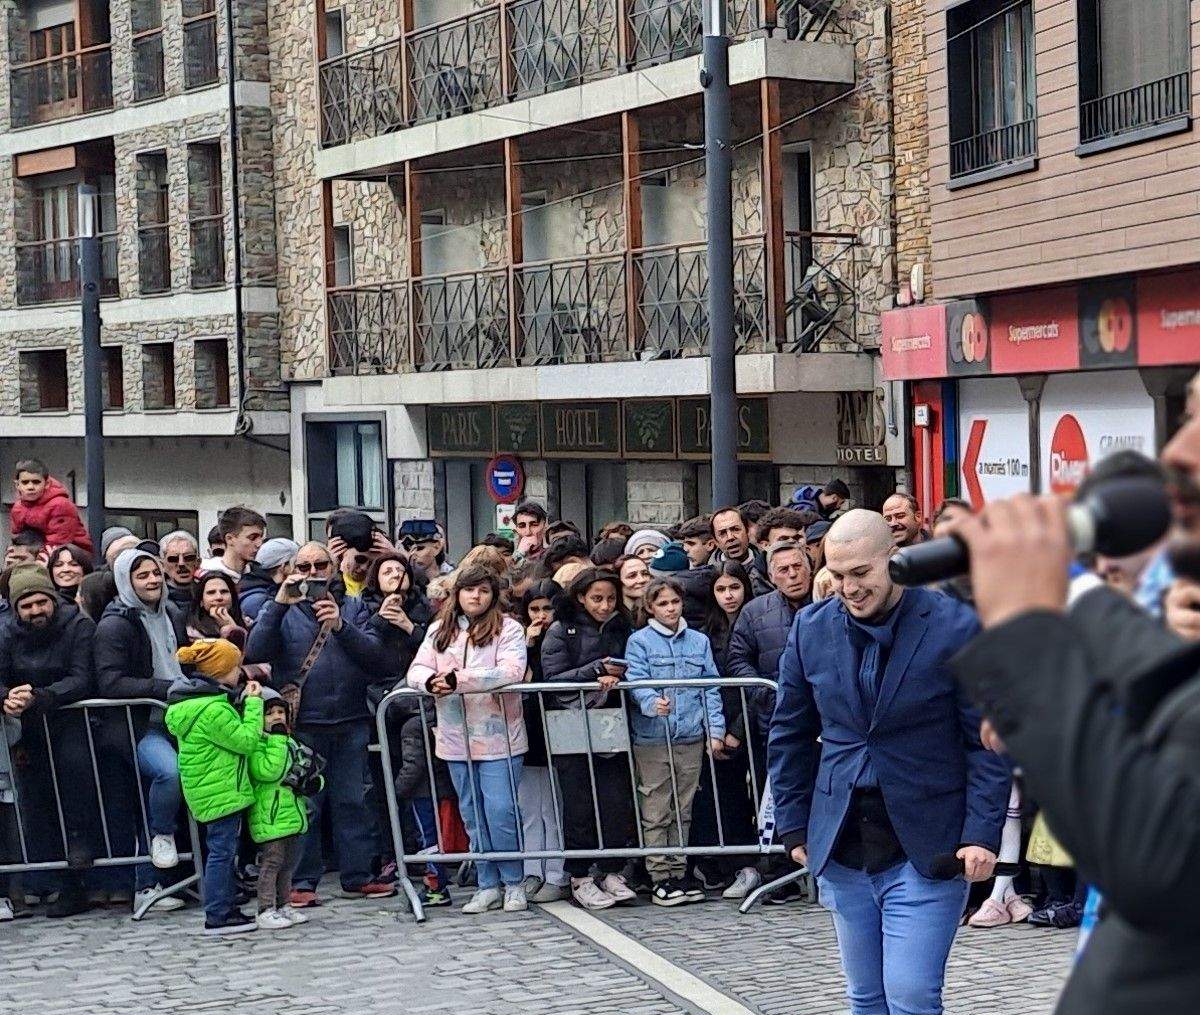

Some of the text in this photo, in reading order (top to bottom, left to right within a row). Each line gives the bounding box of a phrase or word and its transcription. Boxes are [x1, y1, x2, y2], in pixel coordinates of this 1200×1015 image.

[1009, 320, 1059, 345] Supermercats
[442, 411, 481, 445] PARIS
[556, 409, 605, 446] HOTEL
[837, 448, 882, 461] HOTEL
